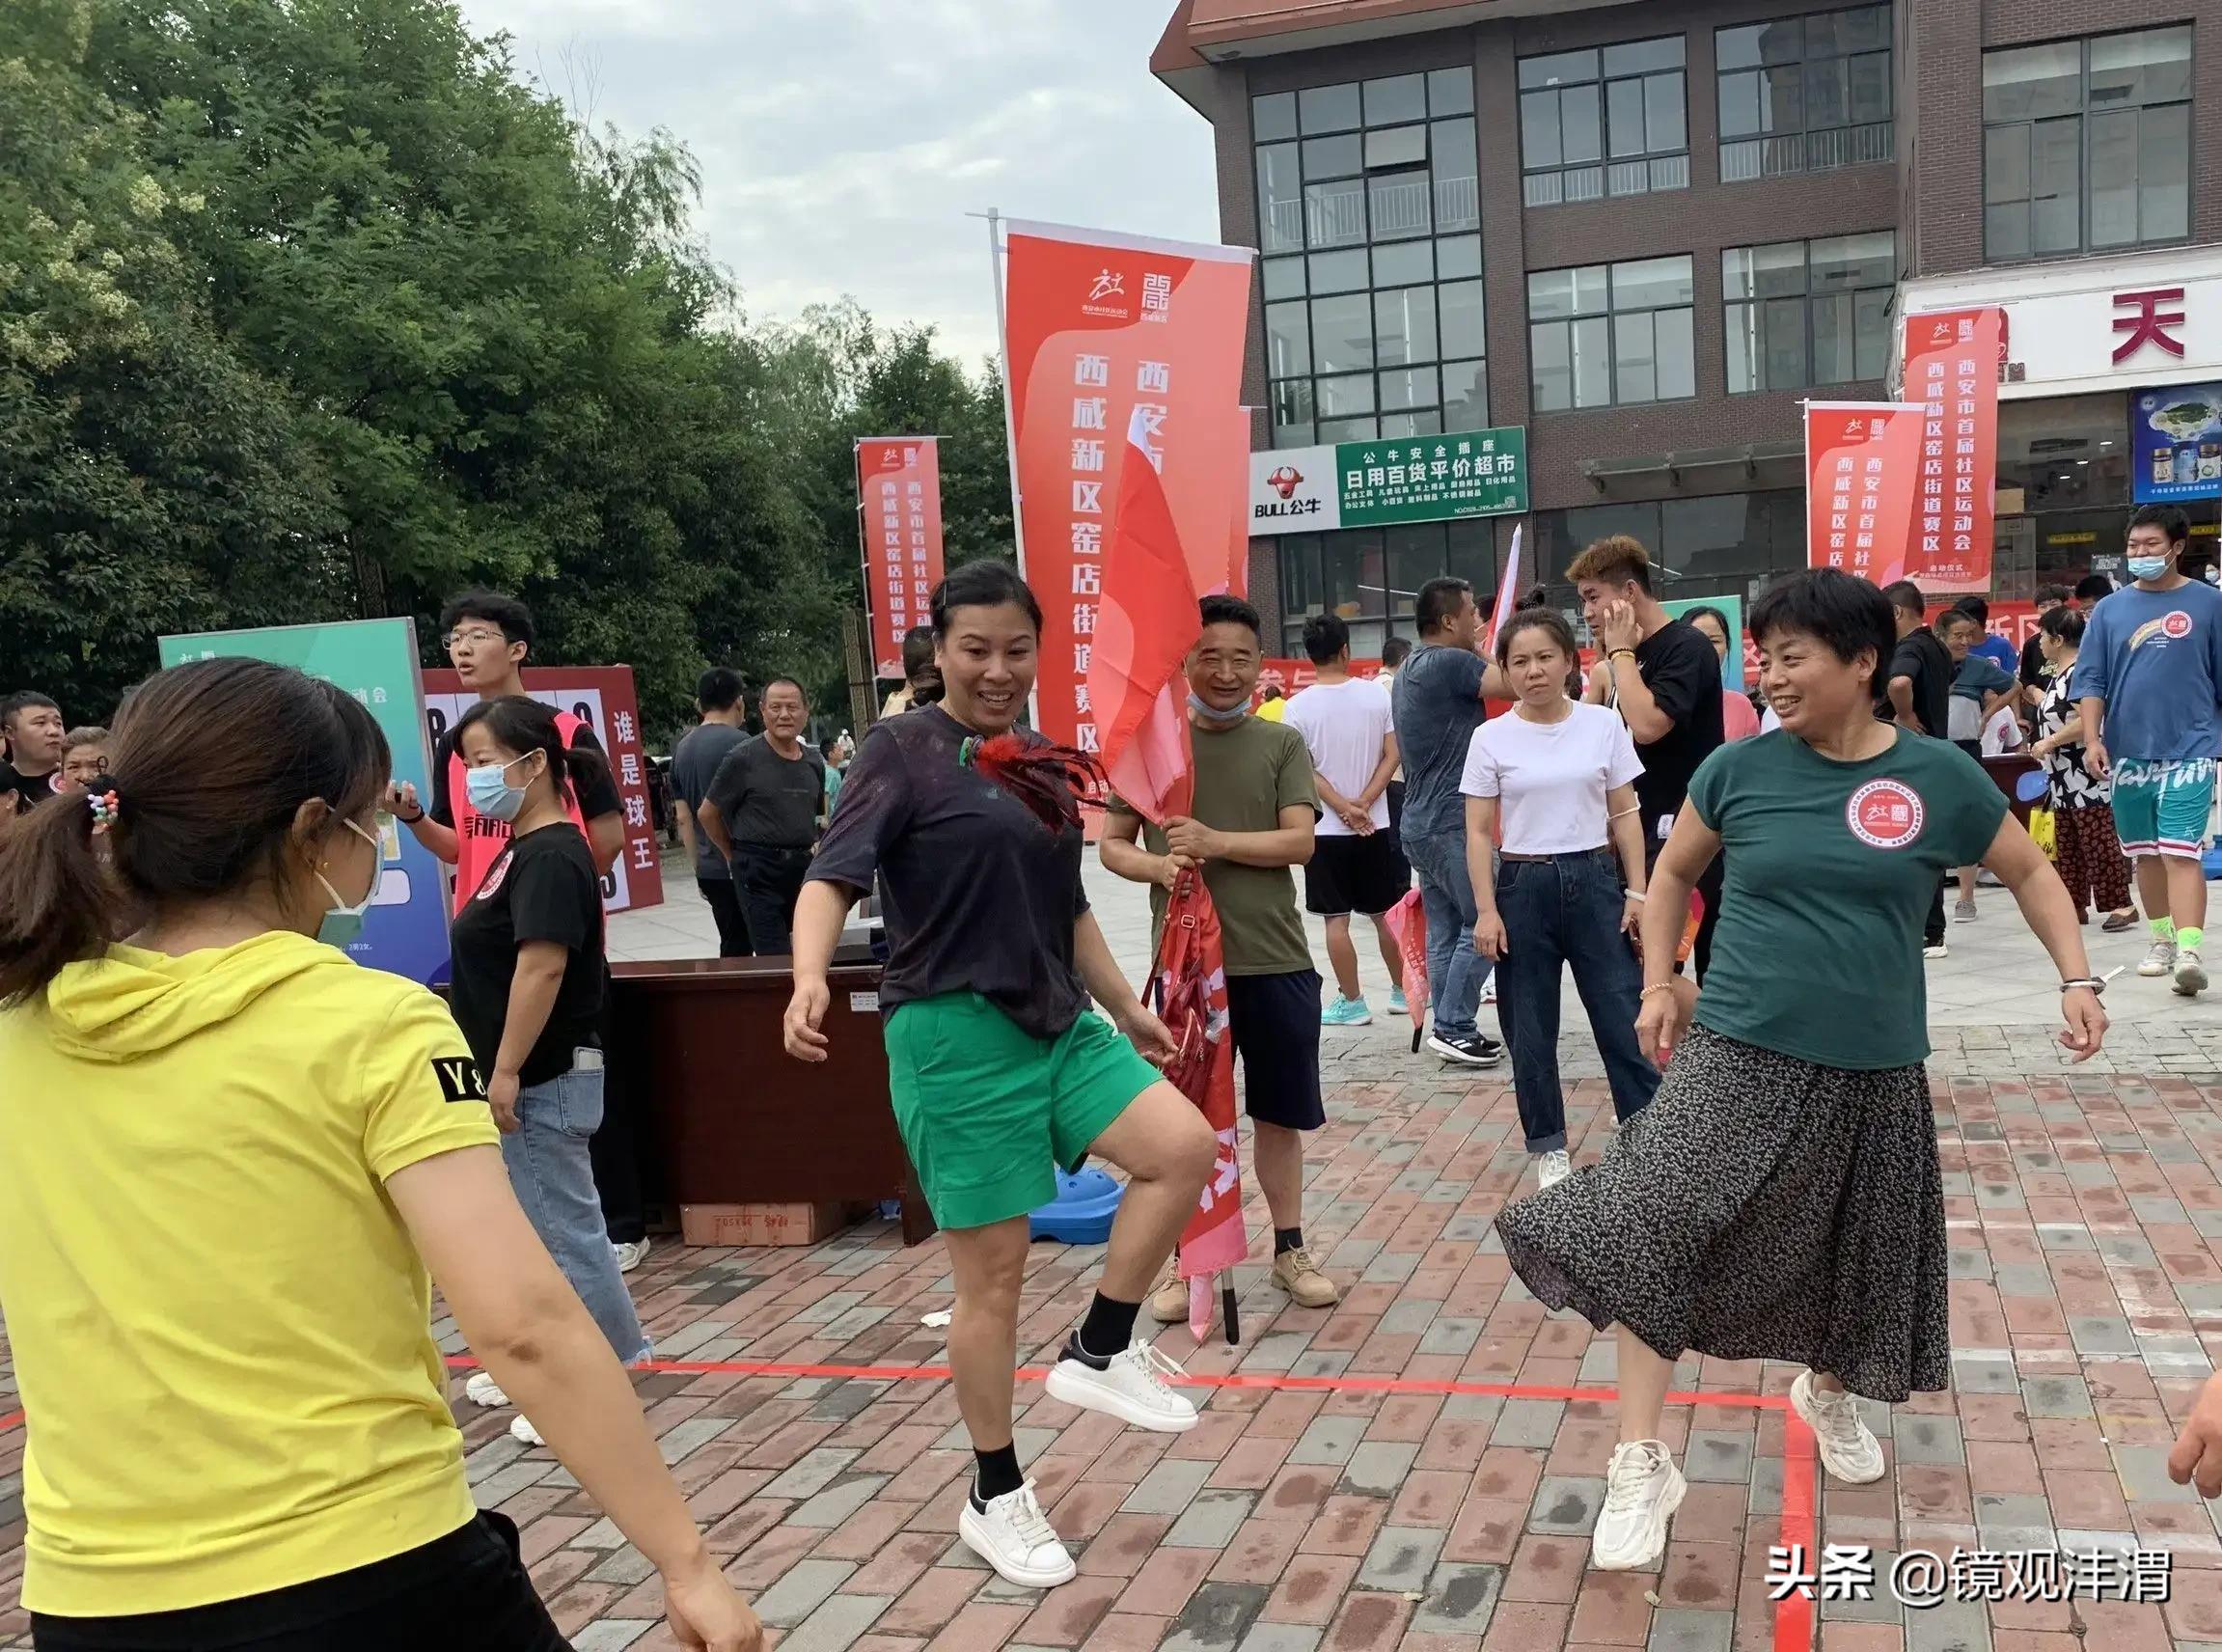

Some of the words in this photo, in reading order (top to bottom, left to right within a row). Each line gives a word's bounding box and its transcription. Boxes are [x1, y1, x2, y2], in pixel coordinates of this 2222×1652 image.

[2112, 288, 2185, 367] 天
[1347, 454, 1516, 489] 日用百货平价超市
[1363, 439, 1495, 464] 公牛安全插座
[1923, 361, 1946, 551] 西咸新区窑店街道赛区
[1954, 358, 1976, 551] 西安市首届社区运动会
[614, 710, 653, 869] 谁是球王
